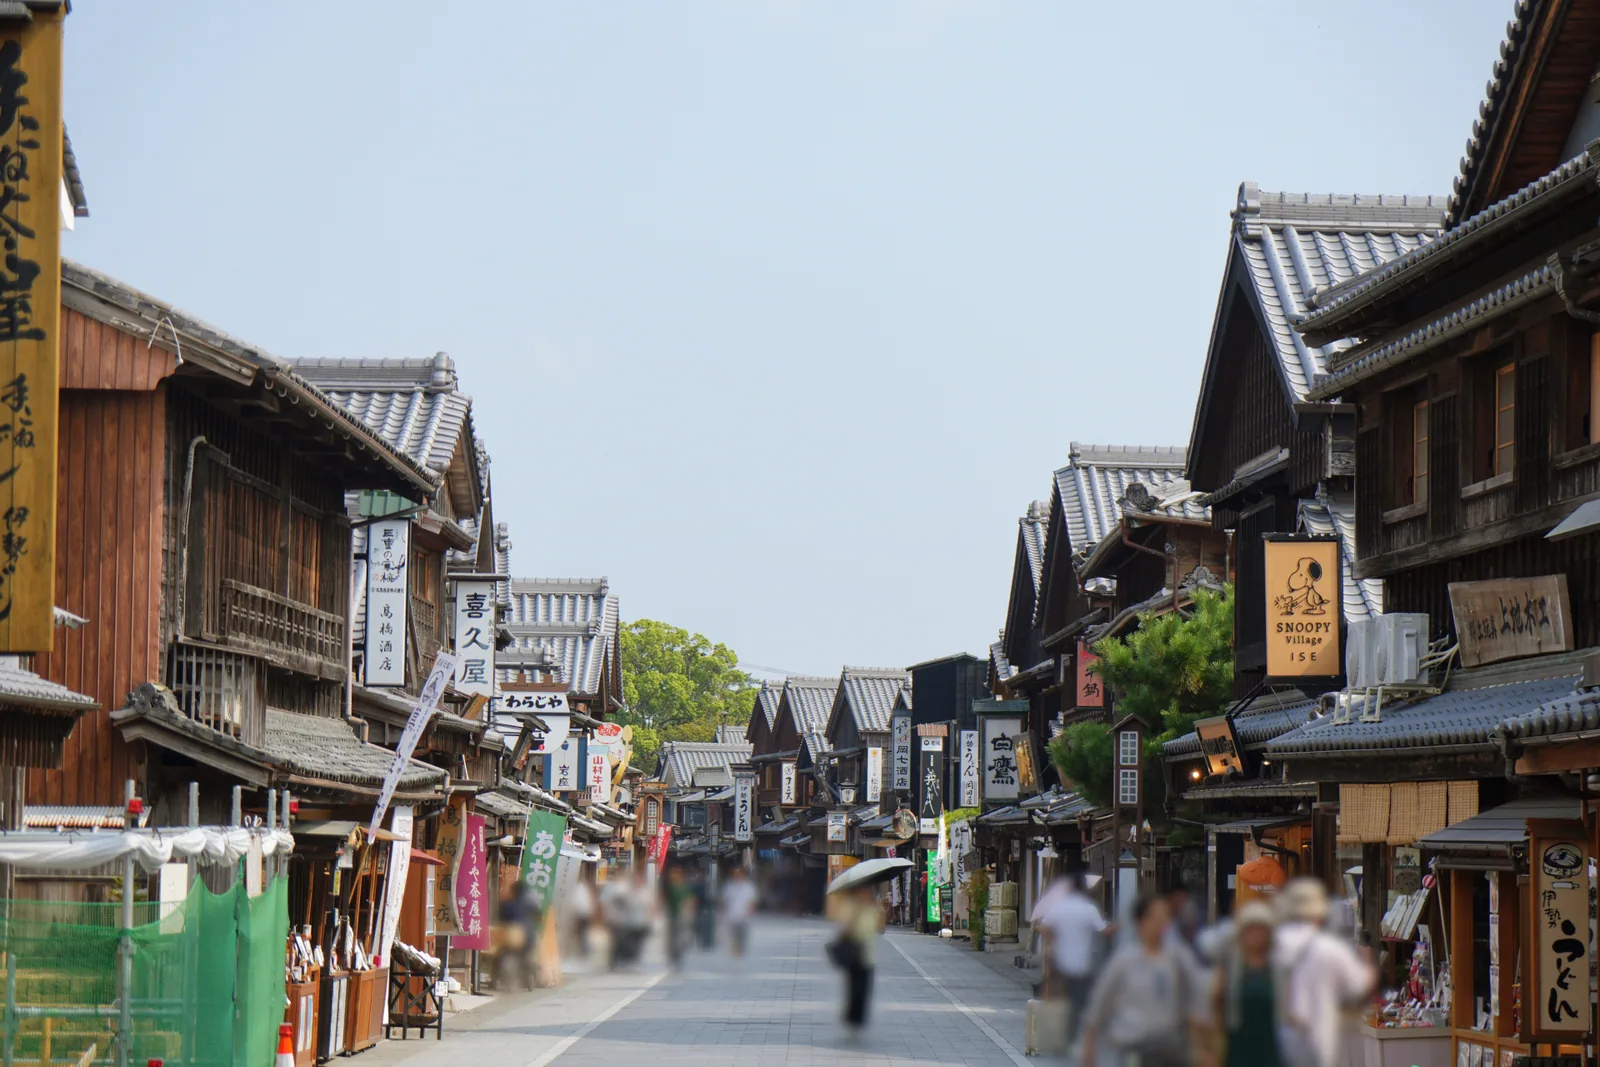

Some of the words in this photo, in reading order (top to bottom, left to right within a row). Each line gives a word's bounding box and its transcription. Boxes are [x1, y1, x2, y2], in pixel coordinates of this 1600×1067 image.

[459, 592, 490, 685] 喜久屋
[1277, 622, 1331, 633] SNOOPY
[1286, 636, 1322, 646] Village
[1291, 652, 1317, 661] ISE
[505, 695, 563, 708] わらじや
[557, 764, 570, 787] 岩座
[592, 755, 604, 794] 山村牛乳
[896, 745, 908, 787] 岡七酒店
[1542, 889, 1585, 1022] 伊勢うどん
